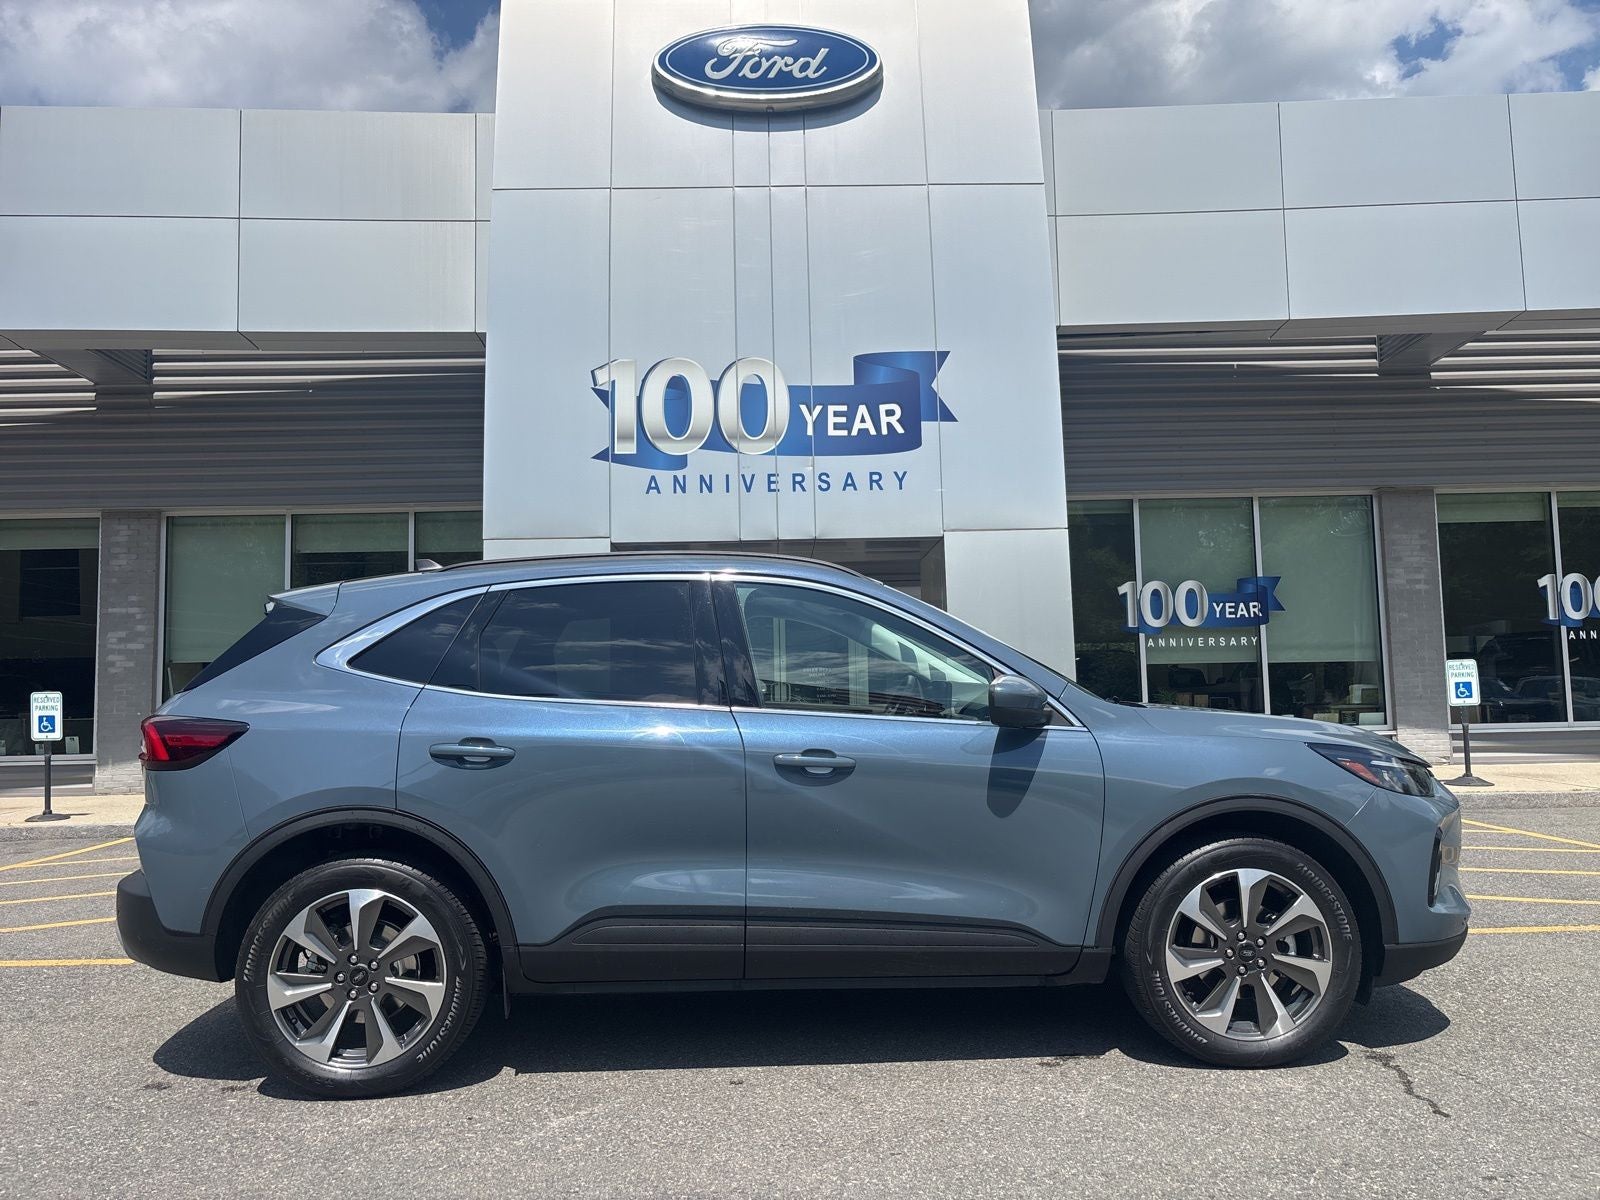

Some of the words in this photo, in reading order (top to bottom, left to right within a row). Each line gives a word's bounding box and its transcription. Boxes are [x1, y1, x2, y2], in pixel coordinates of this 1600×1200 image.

[704, 35, 829, 79] Ford
[591, 357, 790, 455] 100
[799, 403, 905, 437] YEAR
[645, 471, 908, 495] ANNIVERSARY
[1117, 580, 1209, 628] 100
[1213, 601, 1262, 618] YEAR
[1537, 573, 1600, 620] 10
[1147, 636, 1258, 647] ANNIVERSARY
